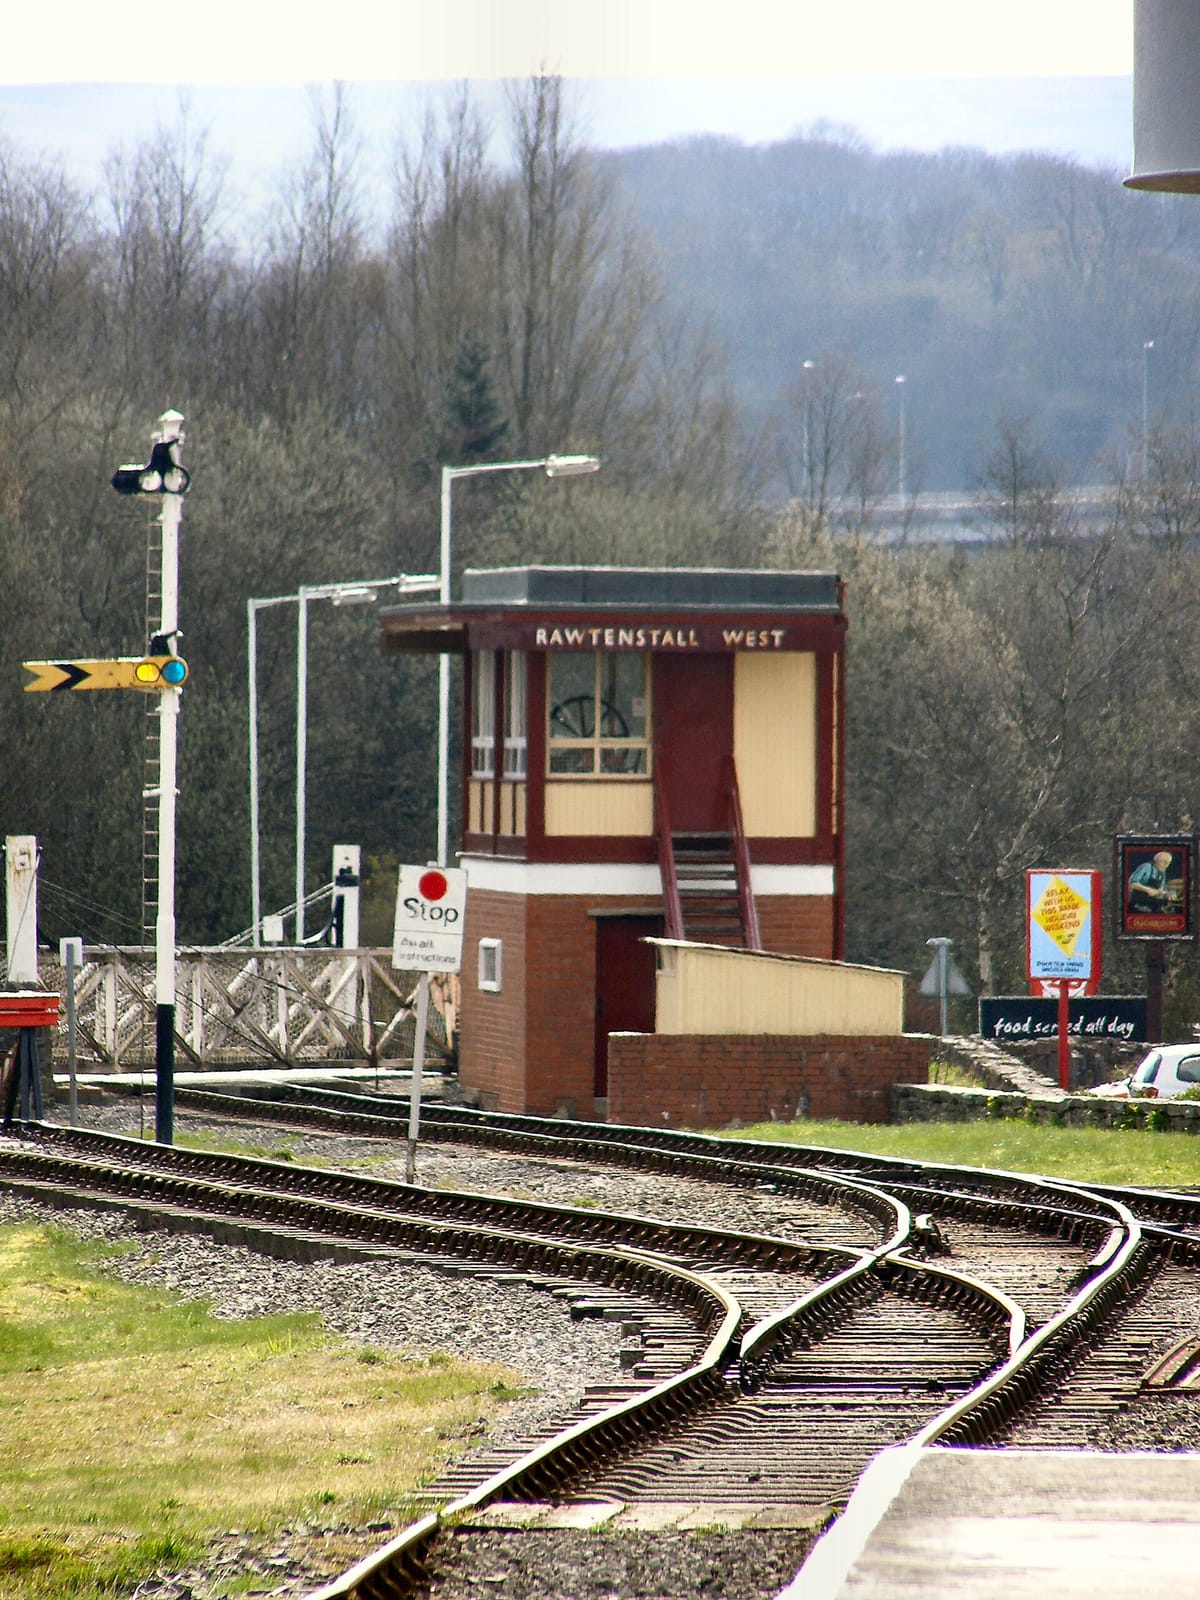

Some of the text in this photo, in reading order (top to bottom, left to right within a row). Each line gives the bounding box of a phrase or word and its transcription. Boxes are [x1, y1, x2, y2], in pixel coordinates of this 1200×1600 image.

[535, 628, 785, 648] RAWTENSTALL WEST
[403, 898, 459, 927] Stop
[993, 1015, 1136, 1039] food sered all day
